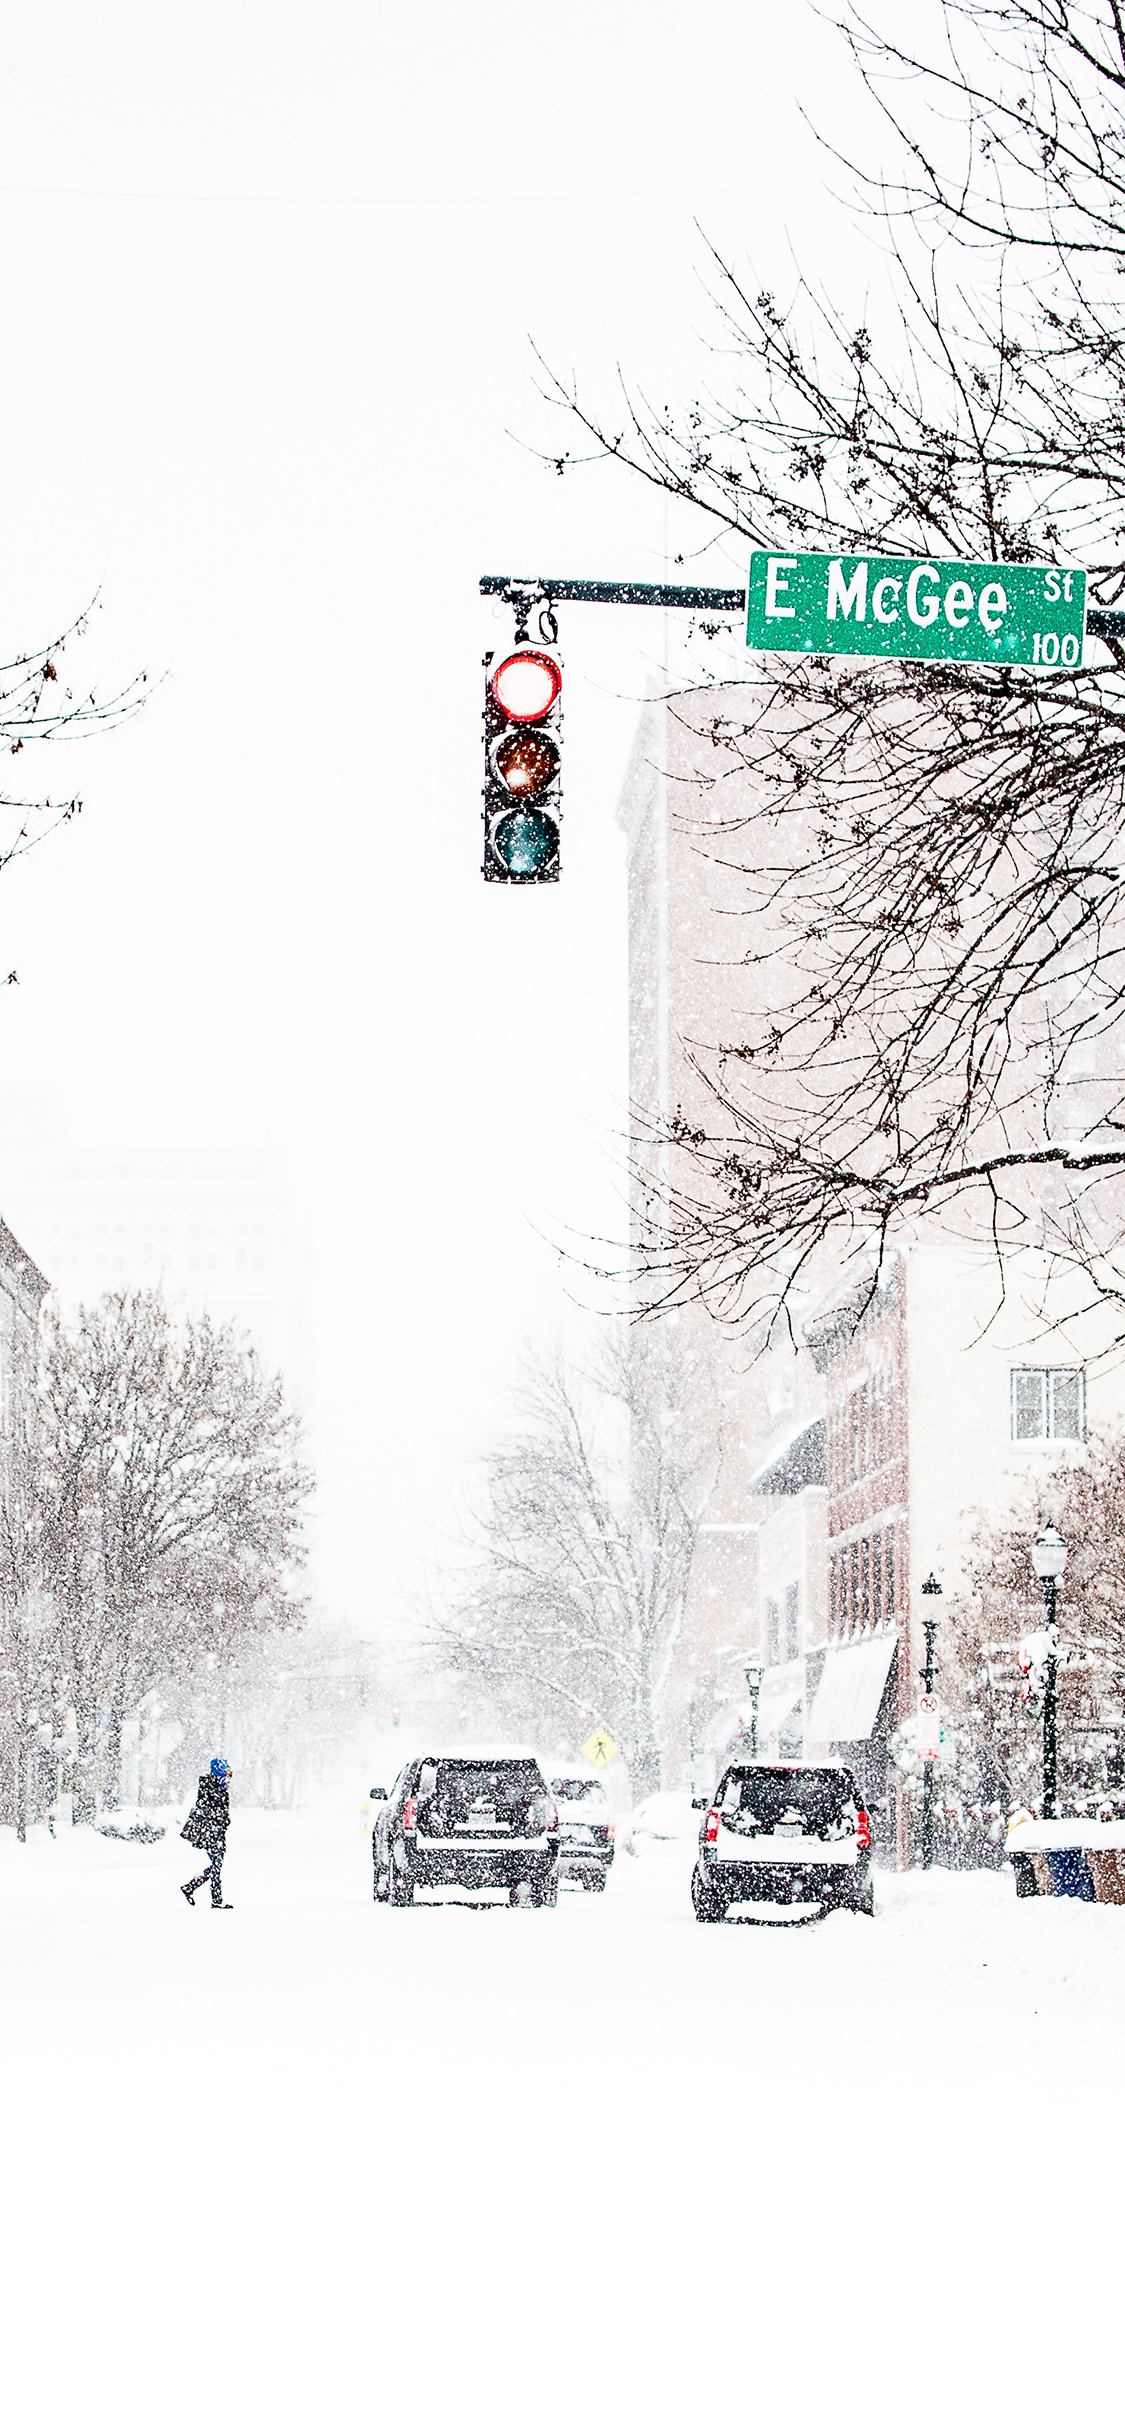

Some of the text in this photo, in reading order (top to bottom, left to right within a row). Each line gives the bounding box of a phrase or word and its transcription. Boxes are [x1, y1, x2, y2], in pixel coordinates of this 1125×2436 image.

[765, 557, 1074, 630] E McGee St
[1032, 632, 1080, 666] 100
